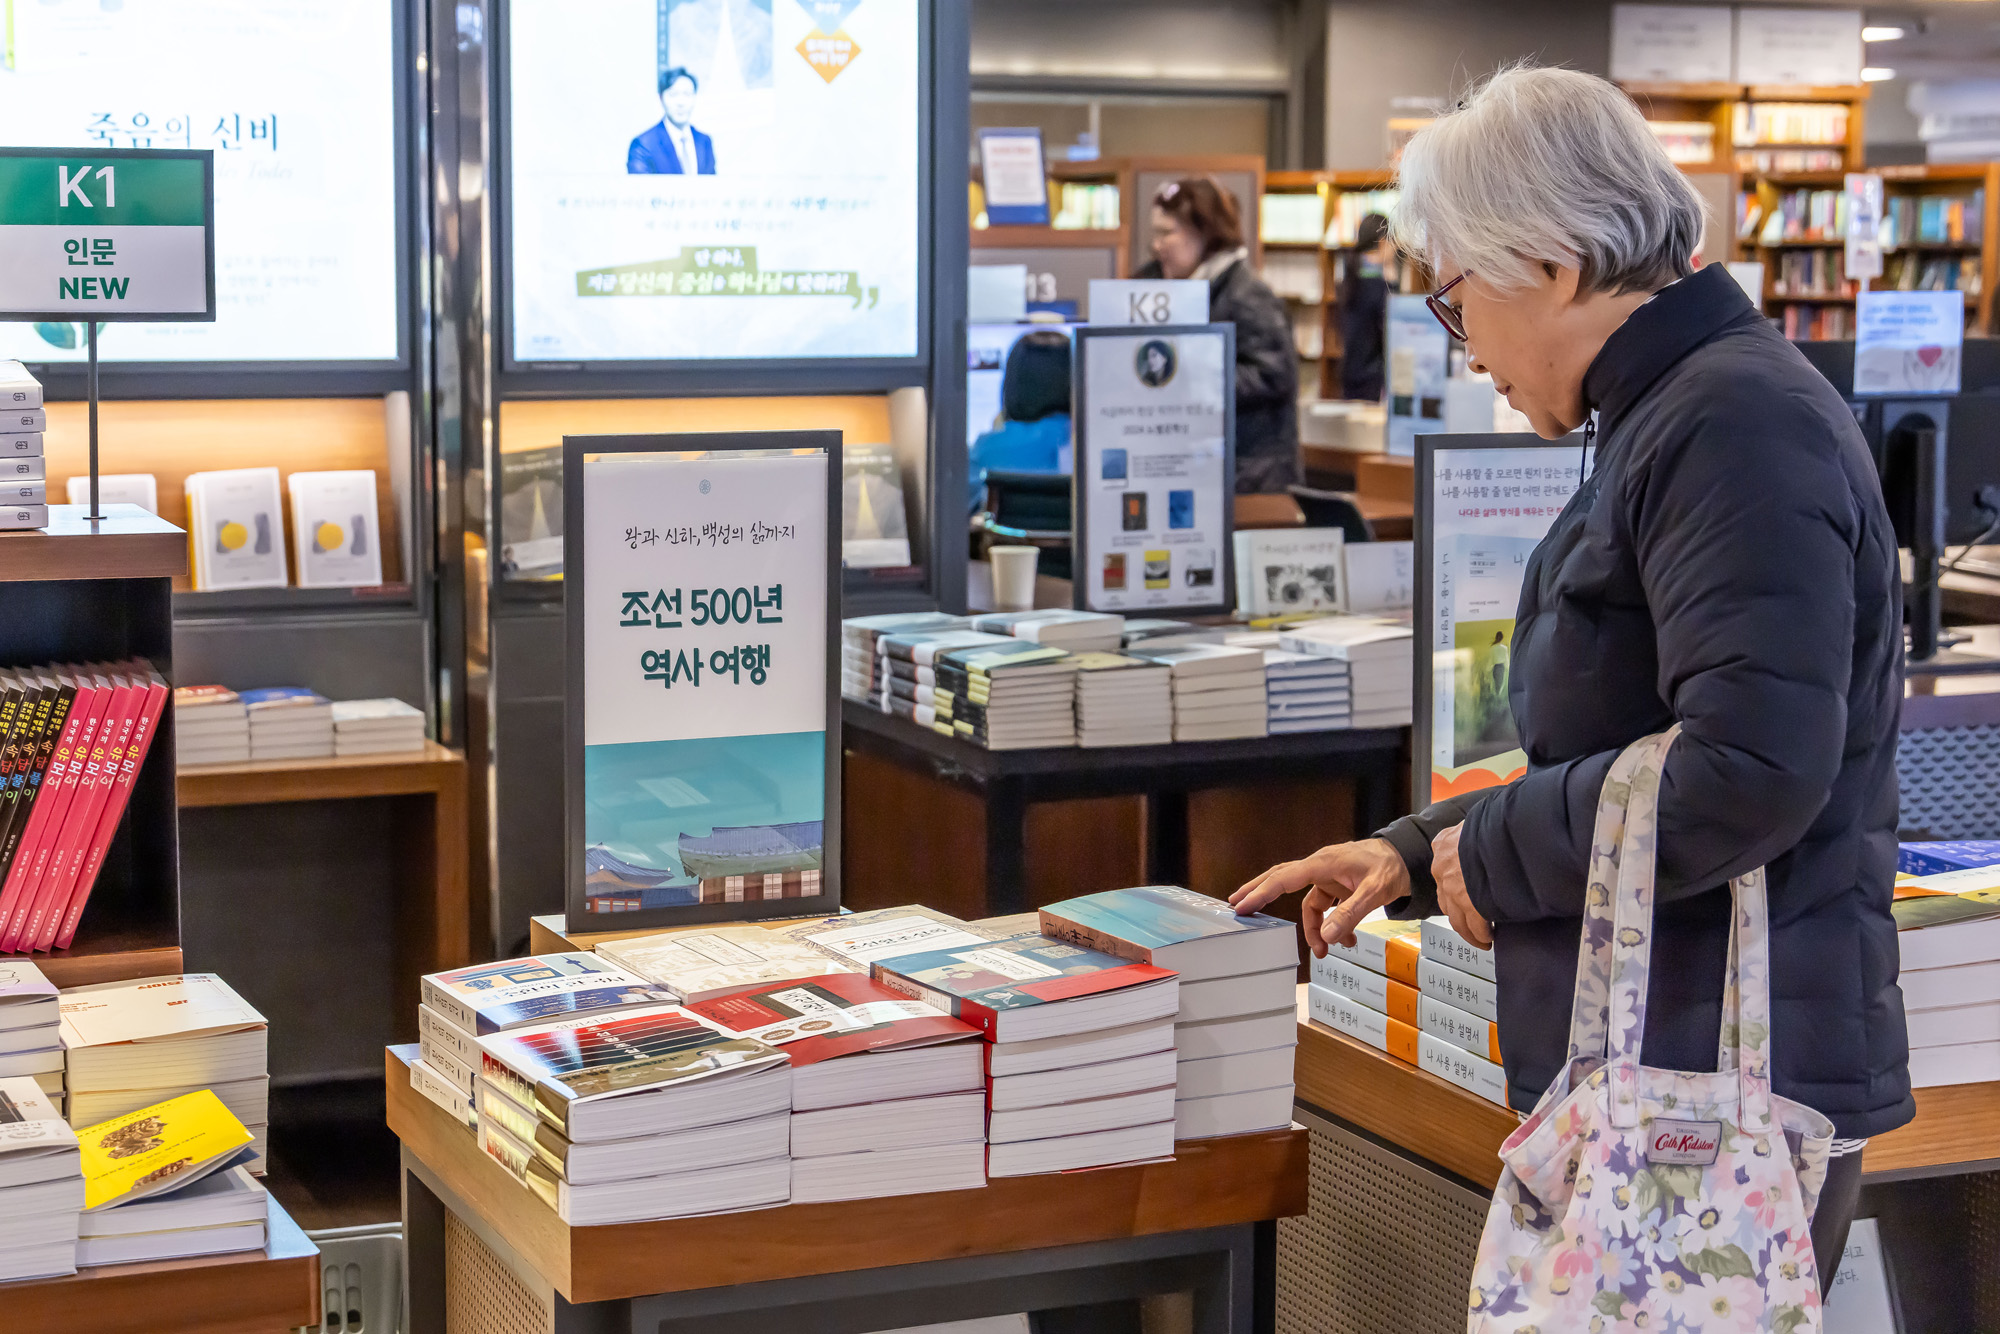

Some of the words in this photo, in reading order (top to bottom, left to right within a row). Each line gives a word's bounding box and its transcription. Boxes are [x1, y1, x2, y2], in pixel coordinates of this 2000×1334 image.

[86, 112, 192, 148] 죽음의
[211, 112, 279, 152] 신비
[58, 165, 116, 208] K1
[63, 237, 117, 266] 인문
[58, 277, 130, 300] NEW
[618, 271, 674, 294] 당신의
[1128, 291, 1172, 324] K8
[1454, 468, 1482, 481] 사용할
[1484, 468, 1493, 480] 줄
[1495, 468, 1522, 480] 모르면
[1442, 486, 1460, 499] 나를
[1462, 486, 1489, 499] 사용할
[1491, 486, 1501, 498] 줄
[1503, 485, 1521, 498] 알면
[1543, 485, 1569, 497] 관계도
[624, 524, 659, 550] 왕과
[749, 519, 796, 546] 삶까지
[620, 587, 683, 628] 조선
[690, 583, 784, 625] 500년
[640, 647, 704, 689] 역사
[709, 643, 772, 686] 여행
[65, 719, 80, 744] 한국의
[83, 717, 97, 743] 한국의
[100, 719, 115, 744] 한국의
[118, 718, 133, 744] 한국의
[134, 717, 149, 741] 한국의
[47, 747, 70, 791] 유모어
[64, 746, 87, 789] 유모어
[81, 747, 104, 790] 유모어
[100, 746, 123, 790] 유모어
[117, 745, 139, 788] 유모어
[1428, 935, 1437, 949] 나
[1438, 939, 1454, 956] 사용
[1456, 943, 1478, 964] 설명서
[1317, 964, 1324, 976] 나
[1325, 967, 1339, 984] 사용
[1340, 972, 1360, 991] 설명서
[1428, 974, 1436, 987] 나
[1438, 978, 1453, 995] 사용
[1456, 983, 1478, 1004] 설명서
[1315, 999, 1321, 1010] 나
[1323, 1003, 1336, 1019] 사용
[1339, 1009, 1358, 1028] 설명서
[1430, 1012, 1438, 1026] 나
[1440, 1017, 1455, 1034] 사용
[1457, 1022, 1480, 1043] 설명서
[1426, 1048, 1434, 1062] 나
[1436, 1053, 1450, 1072] 사용
[1453, 1060, 1475, 1080] 설명서
[1654, 1133, 1678, 1151] Cath
